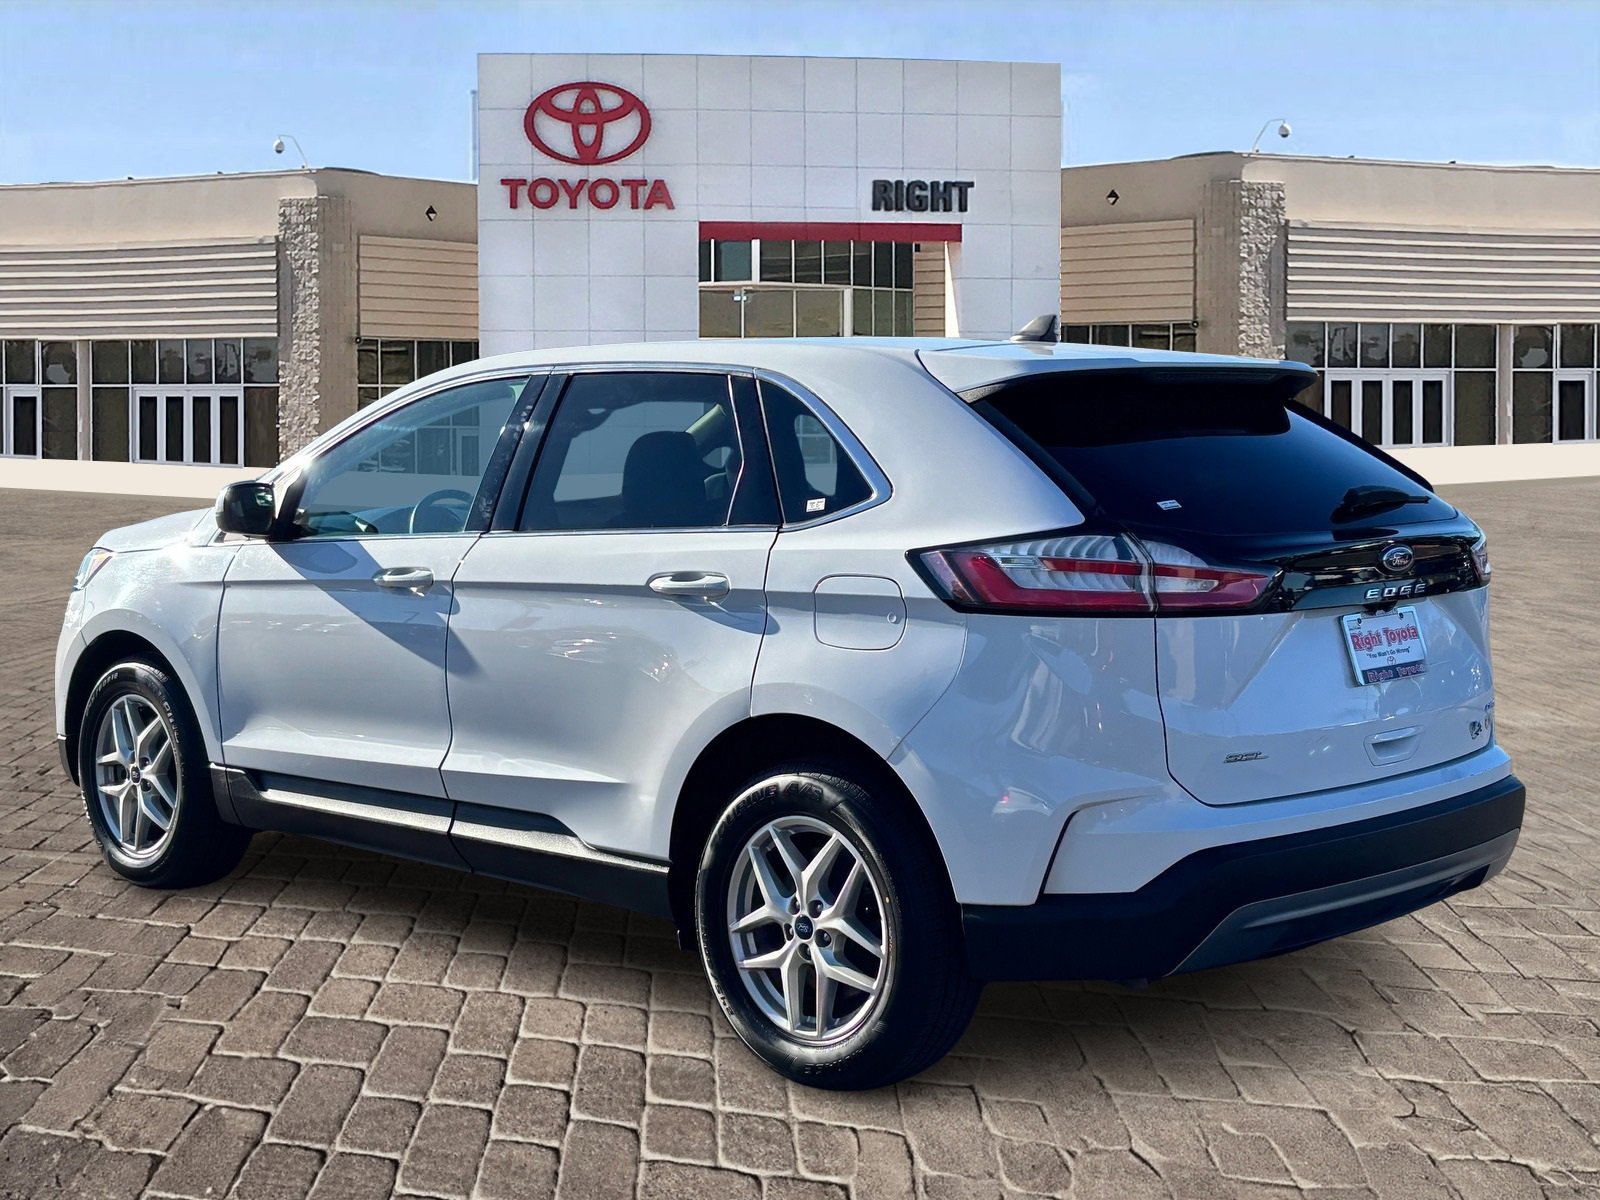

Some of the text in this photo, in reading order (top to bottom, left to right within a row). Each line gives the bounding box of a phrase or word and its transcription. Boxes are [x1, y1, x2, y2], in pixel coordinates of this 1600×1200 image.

[501, 178, 675, 210] TOYOTA
[871, 180, 975, 213] RIGHT
[1365, 583, 1426, 599] EDGE
[1350, 625, 1419, 652] Right Toyota
[1367, 669, 1394, 682] Right
